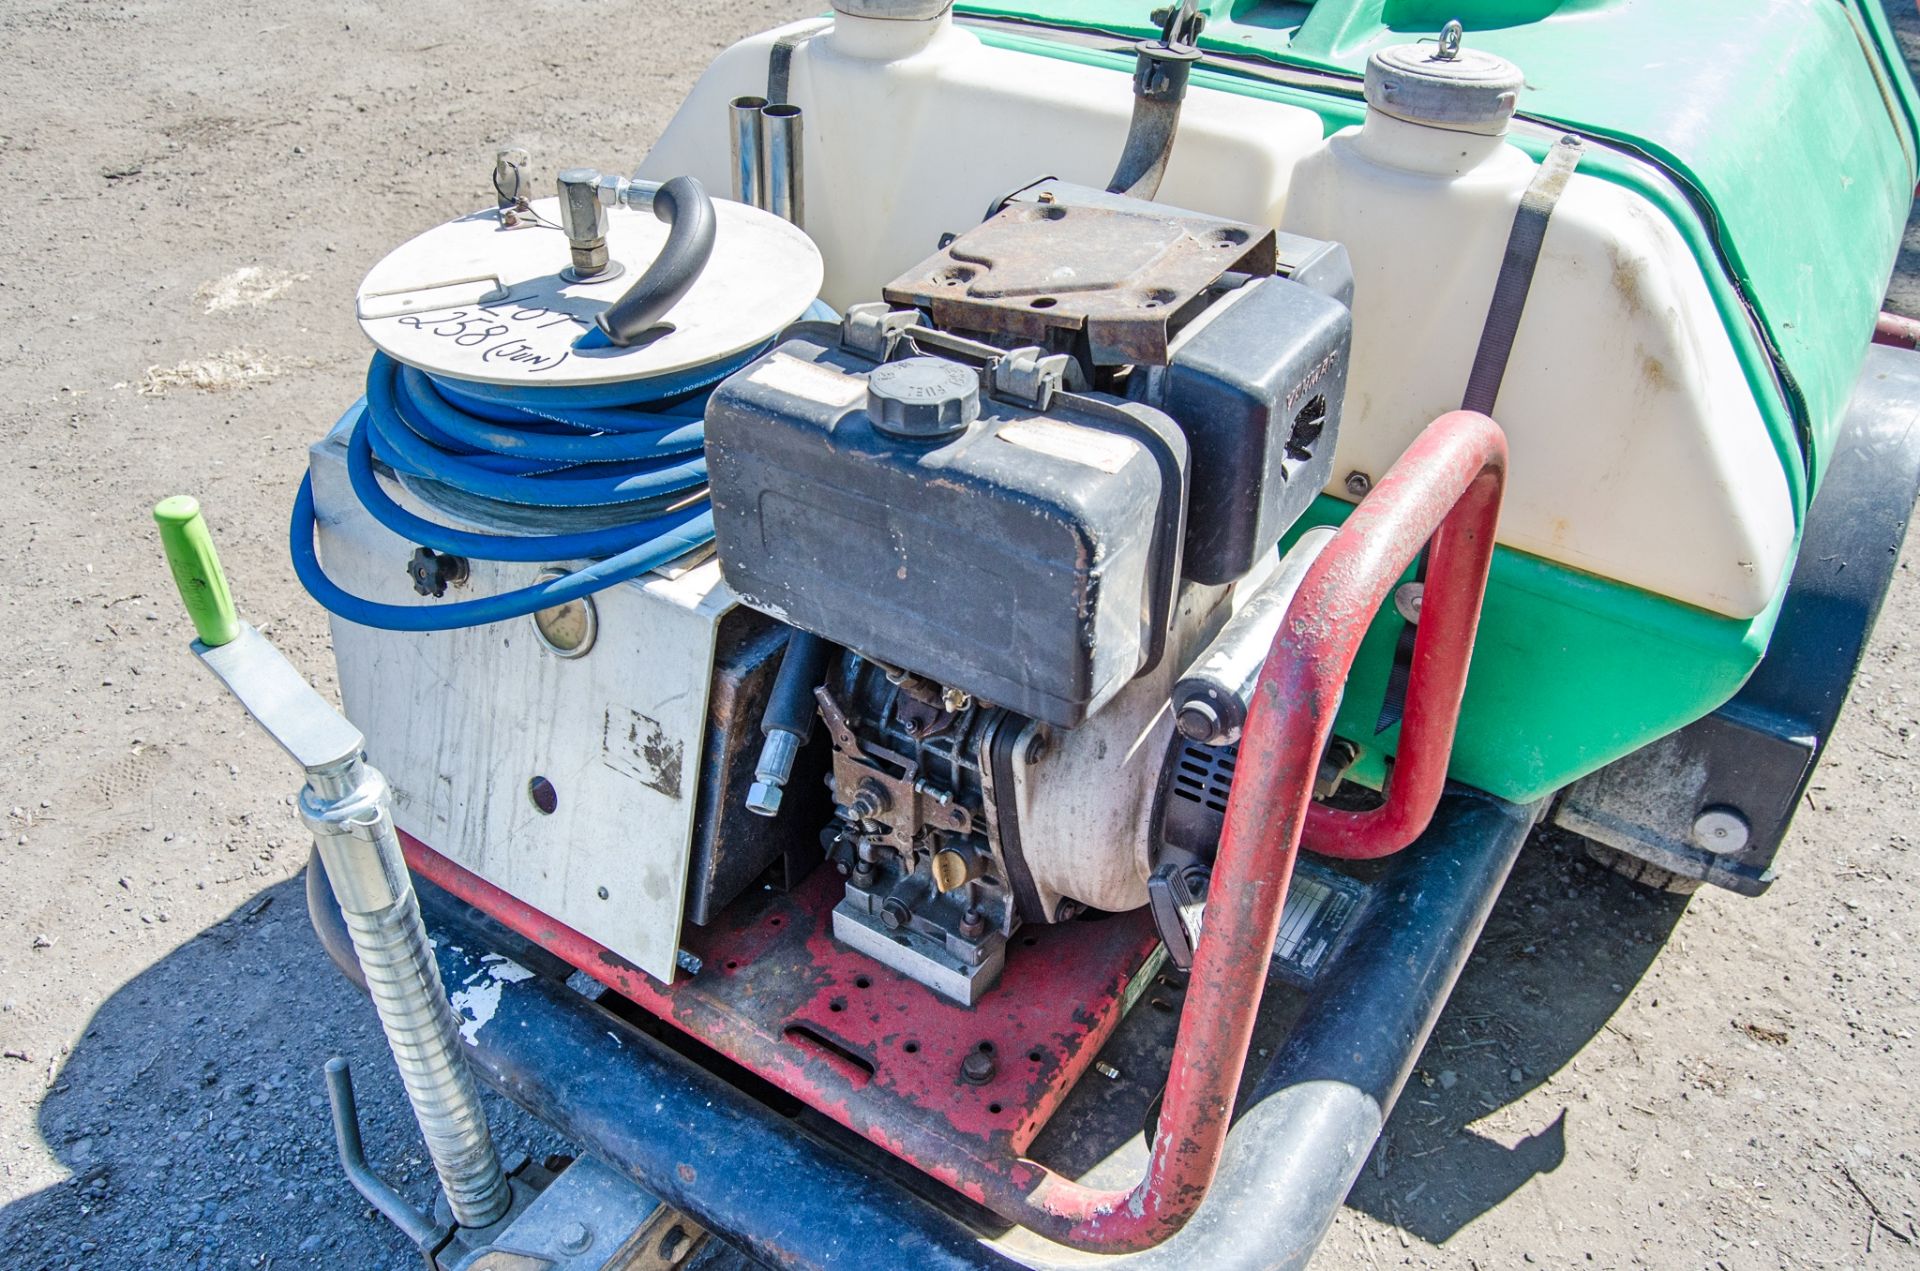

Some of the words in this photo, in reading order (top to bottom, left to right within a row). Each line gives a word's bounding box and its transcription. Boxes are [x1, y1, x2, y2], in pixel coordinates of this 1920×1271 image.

[478, 295, 590, 329] LOT
[398, 311, 509, 347] 258
[482, 338, 570, 373] (JUN)
